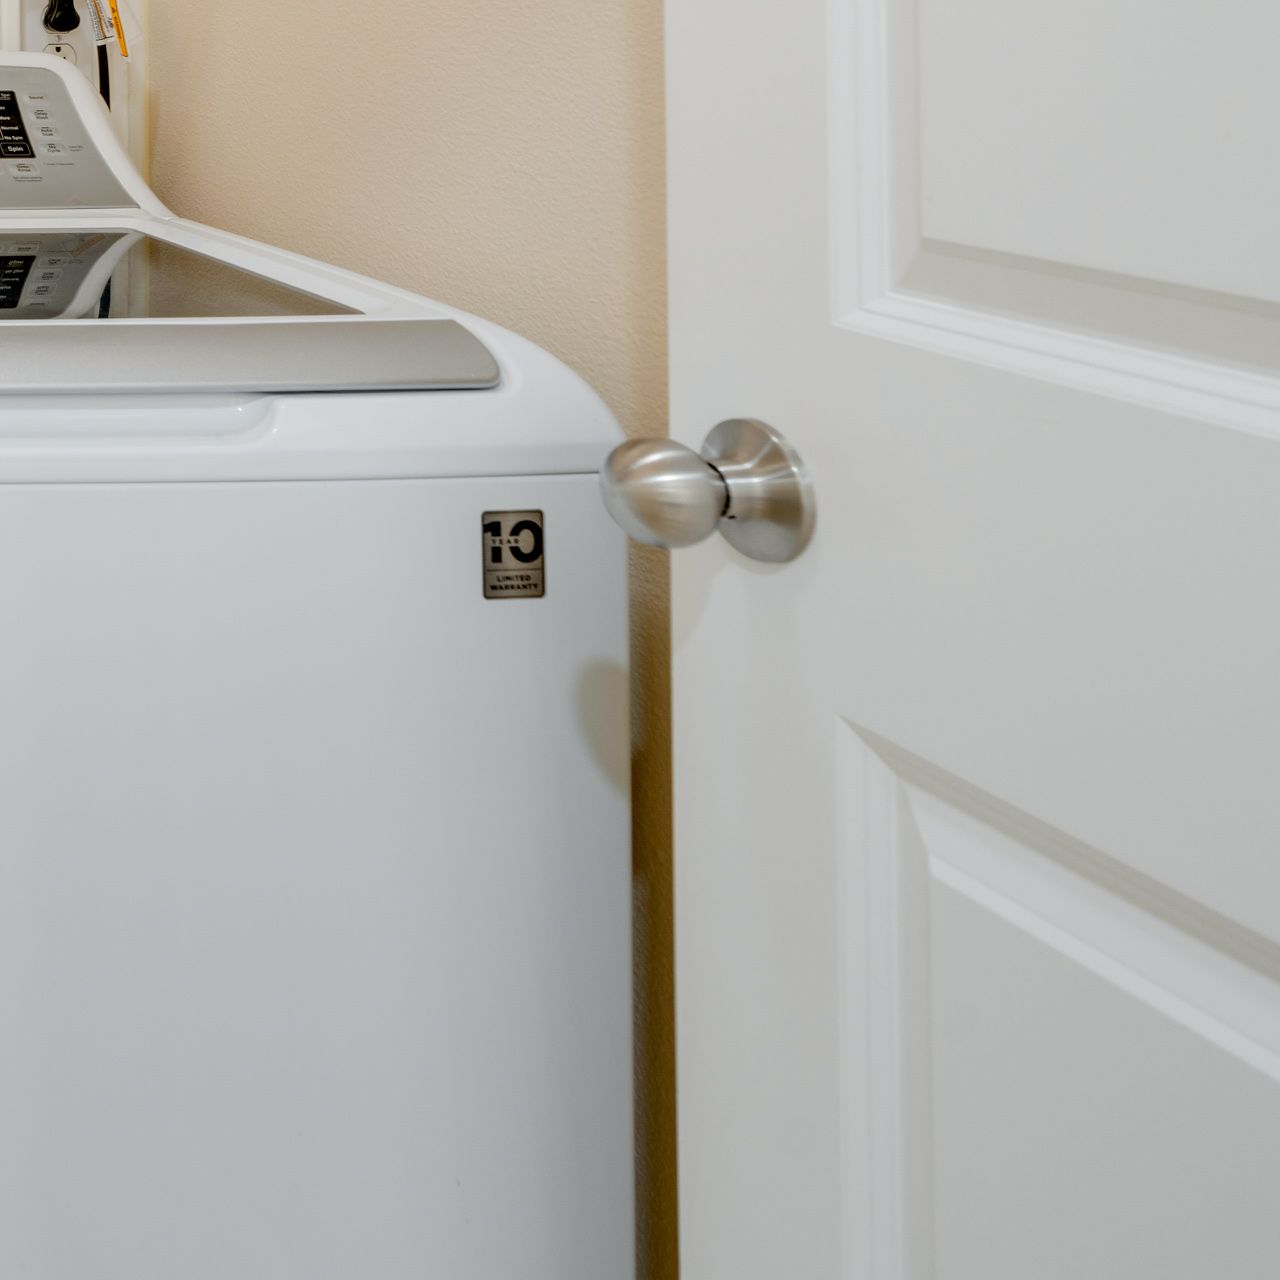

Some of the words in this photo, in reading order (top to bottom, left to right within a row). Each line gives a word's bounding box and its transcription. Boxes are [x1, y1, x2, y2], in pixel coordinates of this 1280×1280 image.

[483, 520, 543, 563] 10
[497, 574, 532, 582] LIMITED
[489, 583, 538, 591] WARRANTY
